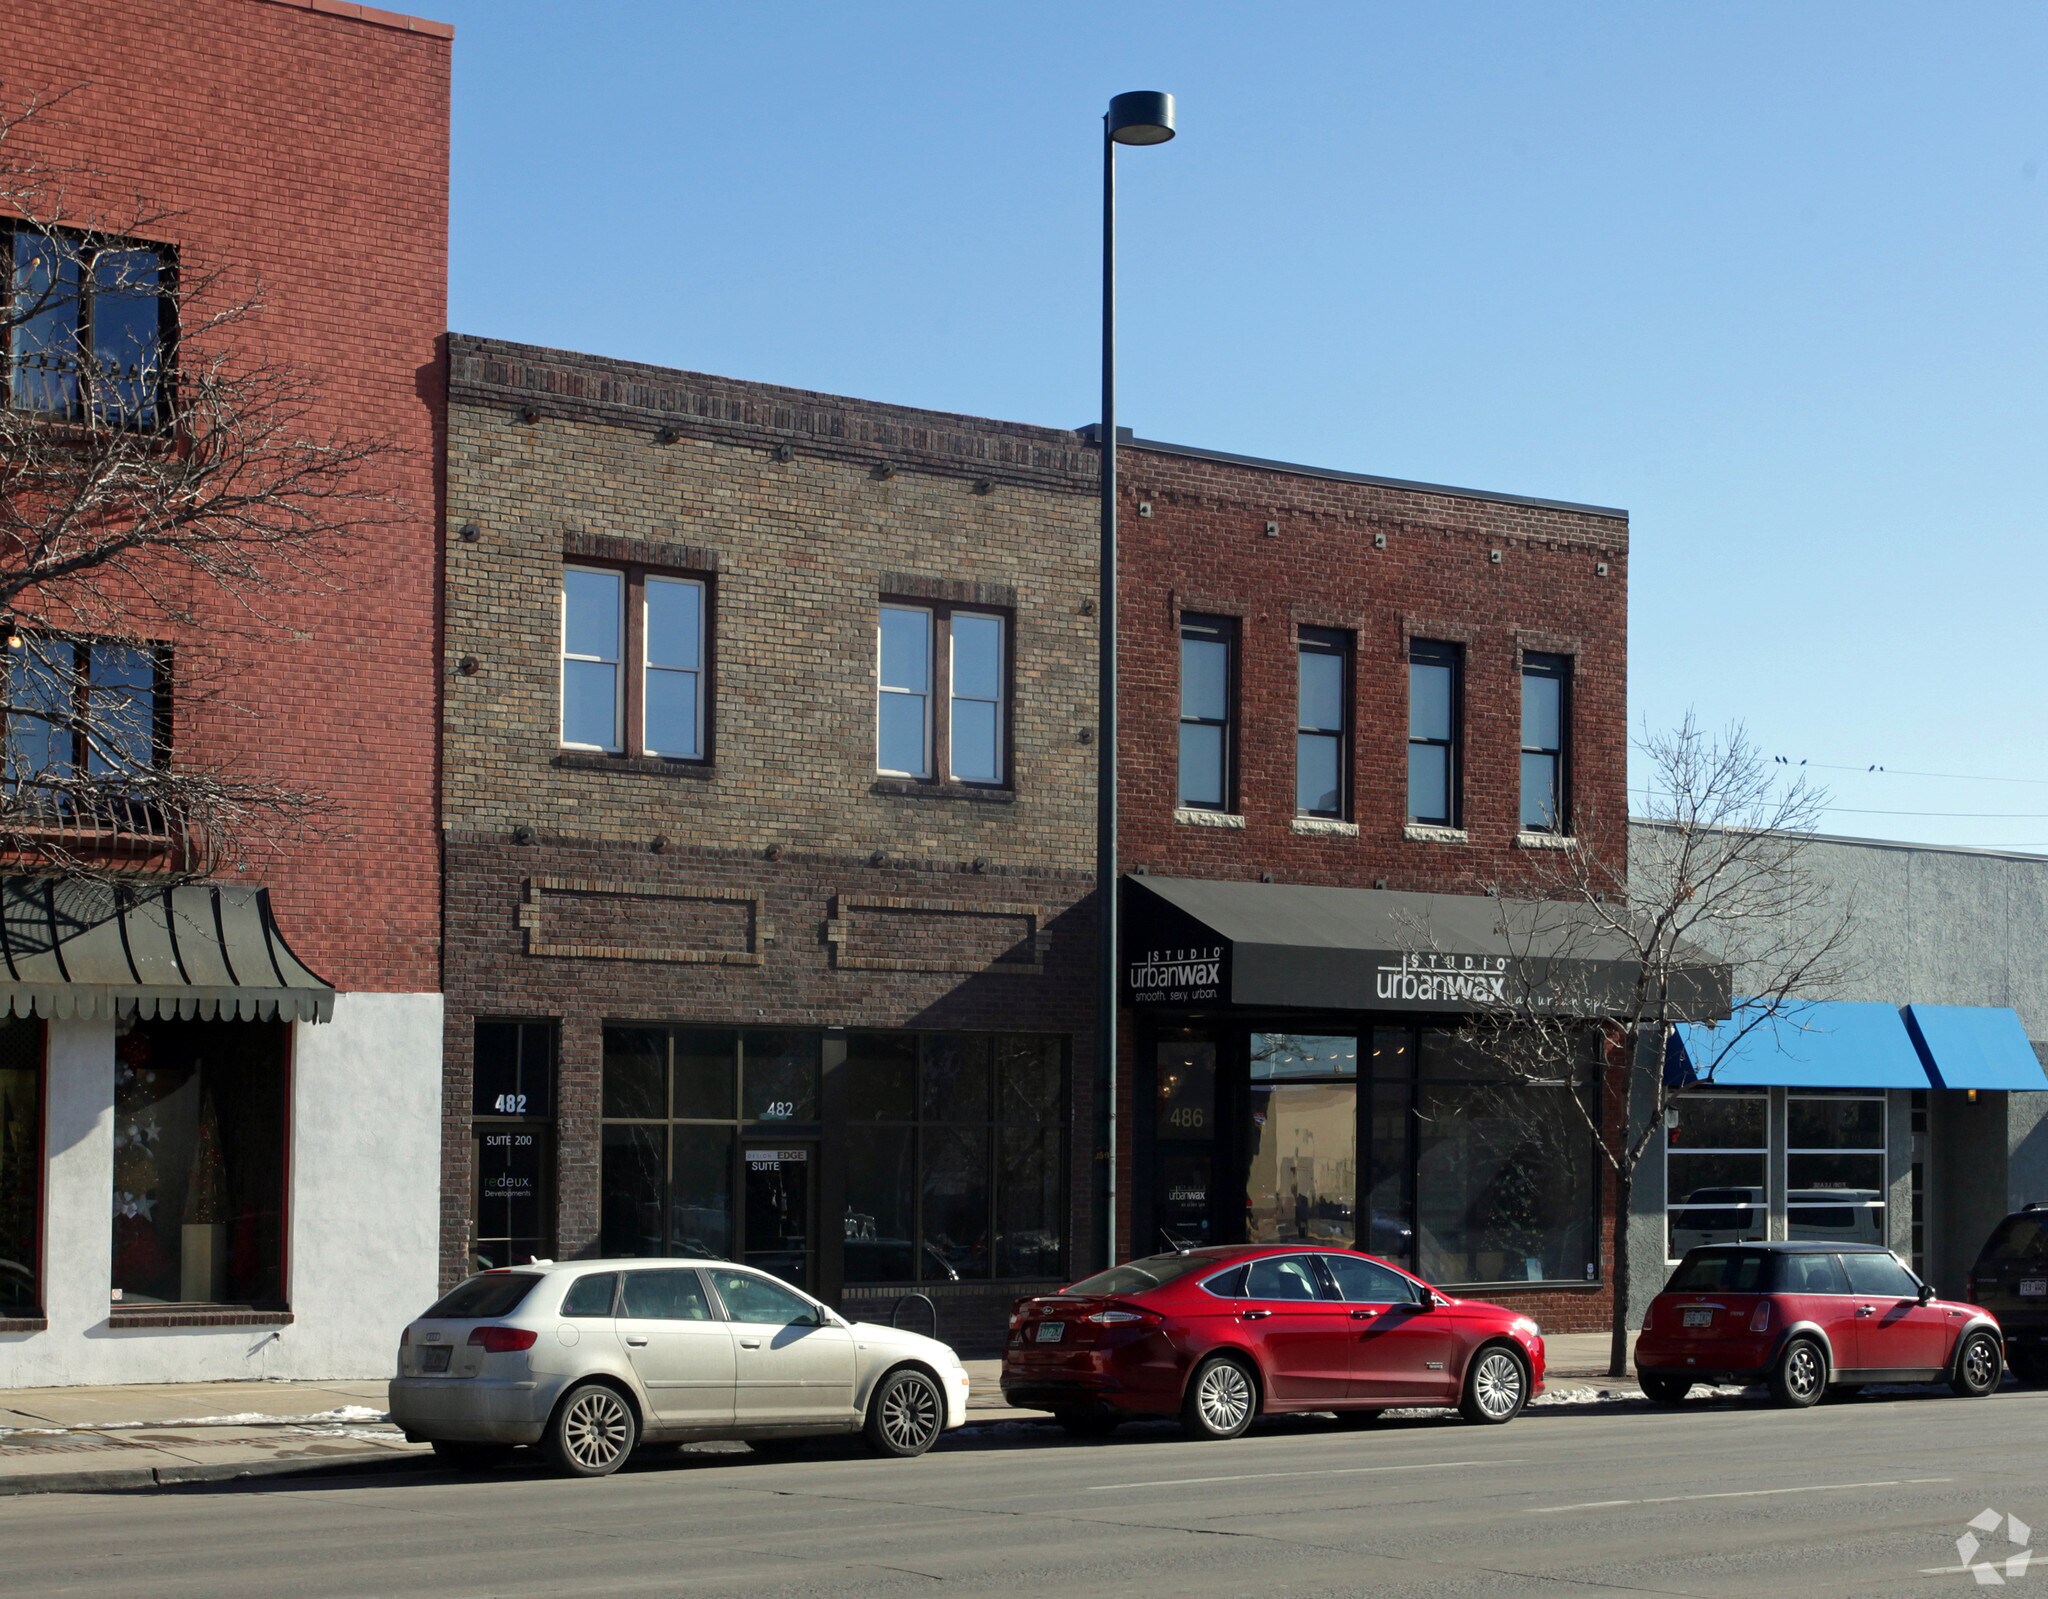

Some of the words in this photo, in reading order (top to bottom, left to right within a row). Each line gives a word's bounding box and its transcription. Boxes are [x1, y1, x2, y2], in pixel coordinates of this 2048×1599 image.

[1153, 947, 1220, 961] STUDIO
[1130, 951, 1220, 988] urbanwax
[1376, 955, 1506, 1002] urbanwax
[494, 1094, 527, 1113] 482
[767, 1101, 794, 1116] 482
[1170, 1108, 1204, 1128] 486
[486, 1135, 512, 1146] SUITE
[514, 1135, 533, 1146] 200
[777, 1151, 804, 1160] EDGE
[751, 1161, 780, 1171] SUITE
[1168, 1185, 1205, 1201] urbanwax
